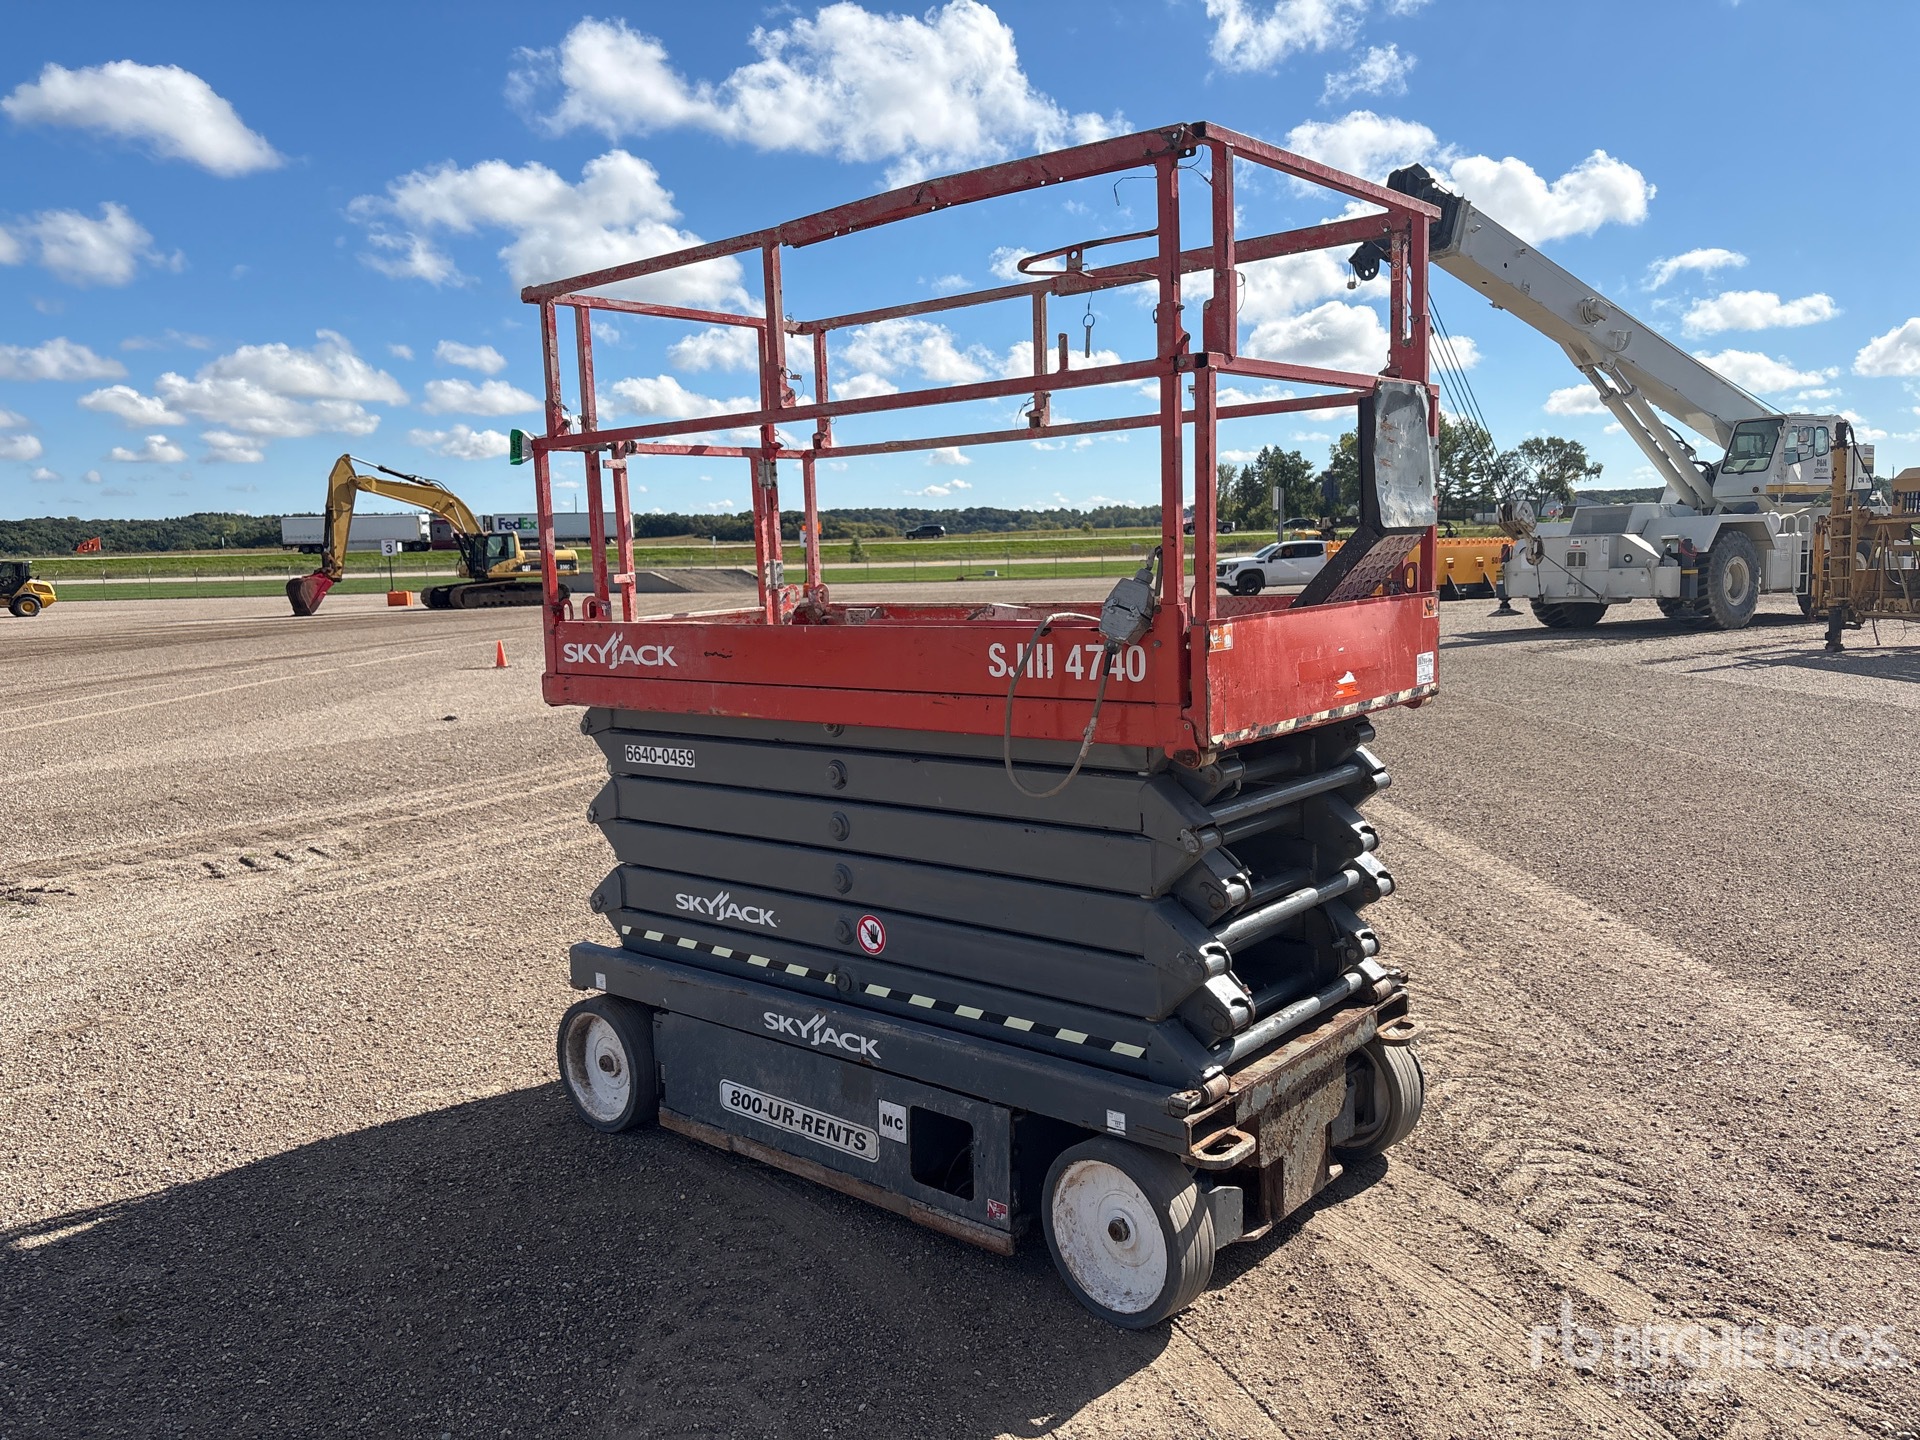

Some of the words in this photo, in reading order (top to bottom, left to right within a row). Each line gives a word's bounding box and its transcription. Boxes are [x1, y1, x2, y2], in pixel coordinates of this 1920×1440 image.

[498, 517, 538, 530] FedEx
[385, 544, 393, 554] 3
[521, 564, 531, 572] CAT
[563, 631, 678, 670] SKYJACK
[625, 745, 694, 766] 6640-0459
[675, 890, 778, 928] SKYJACK
[763, 1011, 882, 1060] SKYJACK
[730, 1089, 867, 1152] 800-UR-RENTS
[882, 1113, 904, 1132] MC
